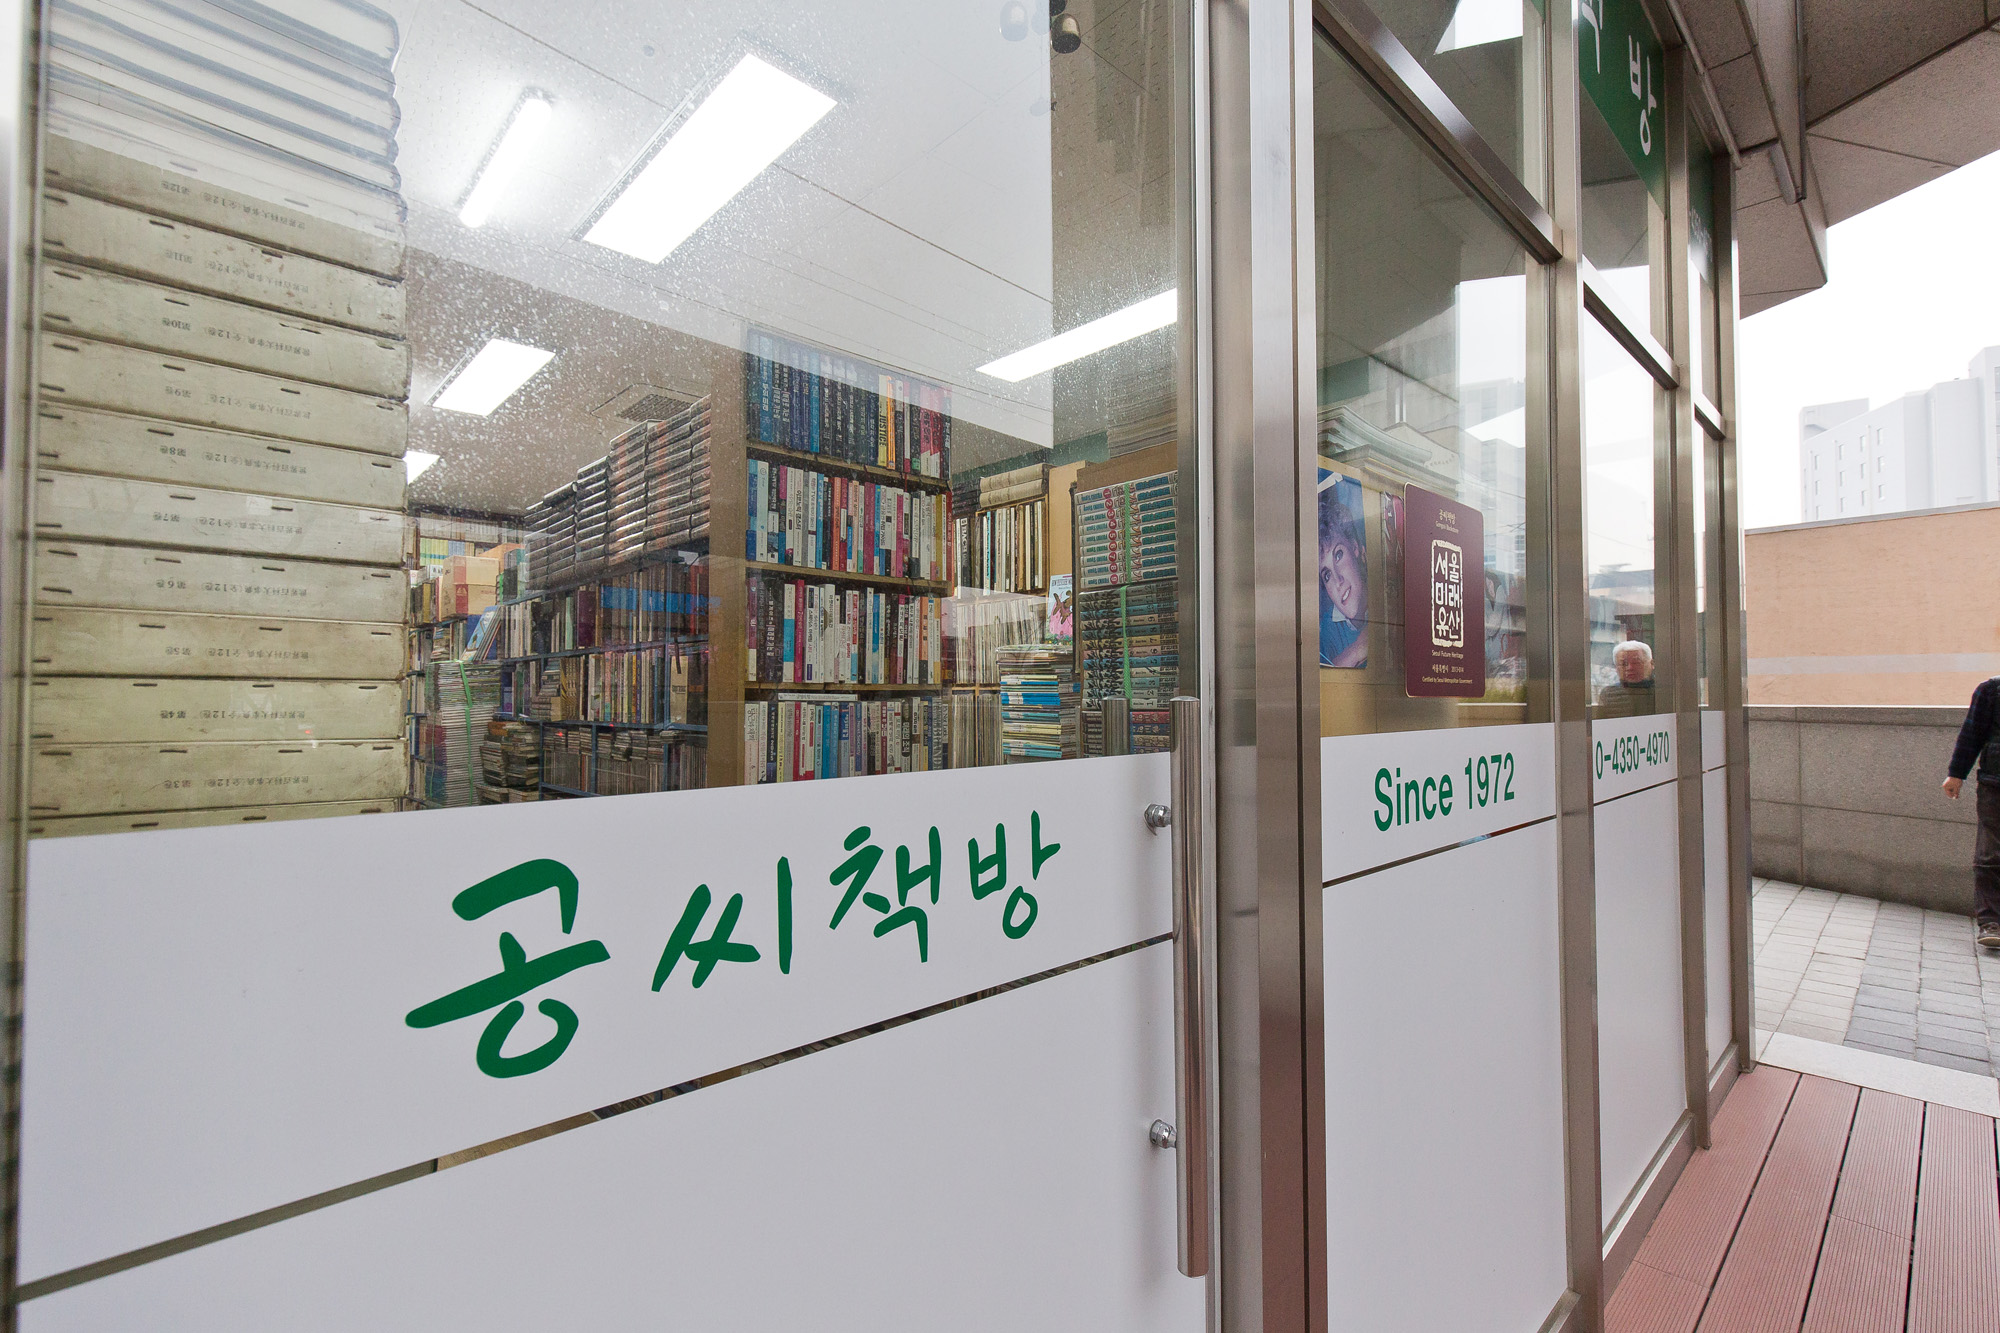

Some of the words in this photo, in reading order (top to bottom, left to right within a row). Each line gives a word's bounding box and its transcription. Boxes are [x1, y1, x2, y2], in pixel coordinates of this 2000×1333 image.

[1435, 551, 1460, 583] 서울
[1435, 582, 1460, 608] 미래
[1436, 606, 1461, 640] 유산
[902, 740, 910, 753] 조직
[1373, 766, 1454, 832] Since
[1464, 752, 1516, 810] 1972
[404, 809, 1061, 1079] 공씨책방
